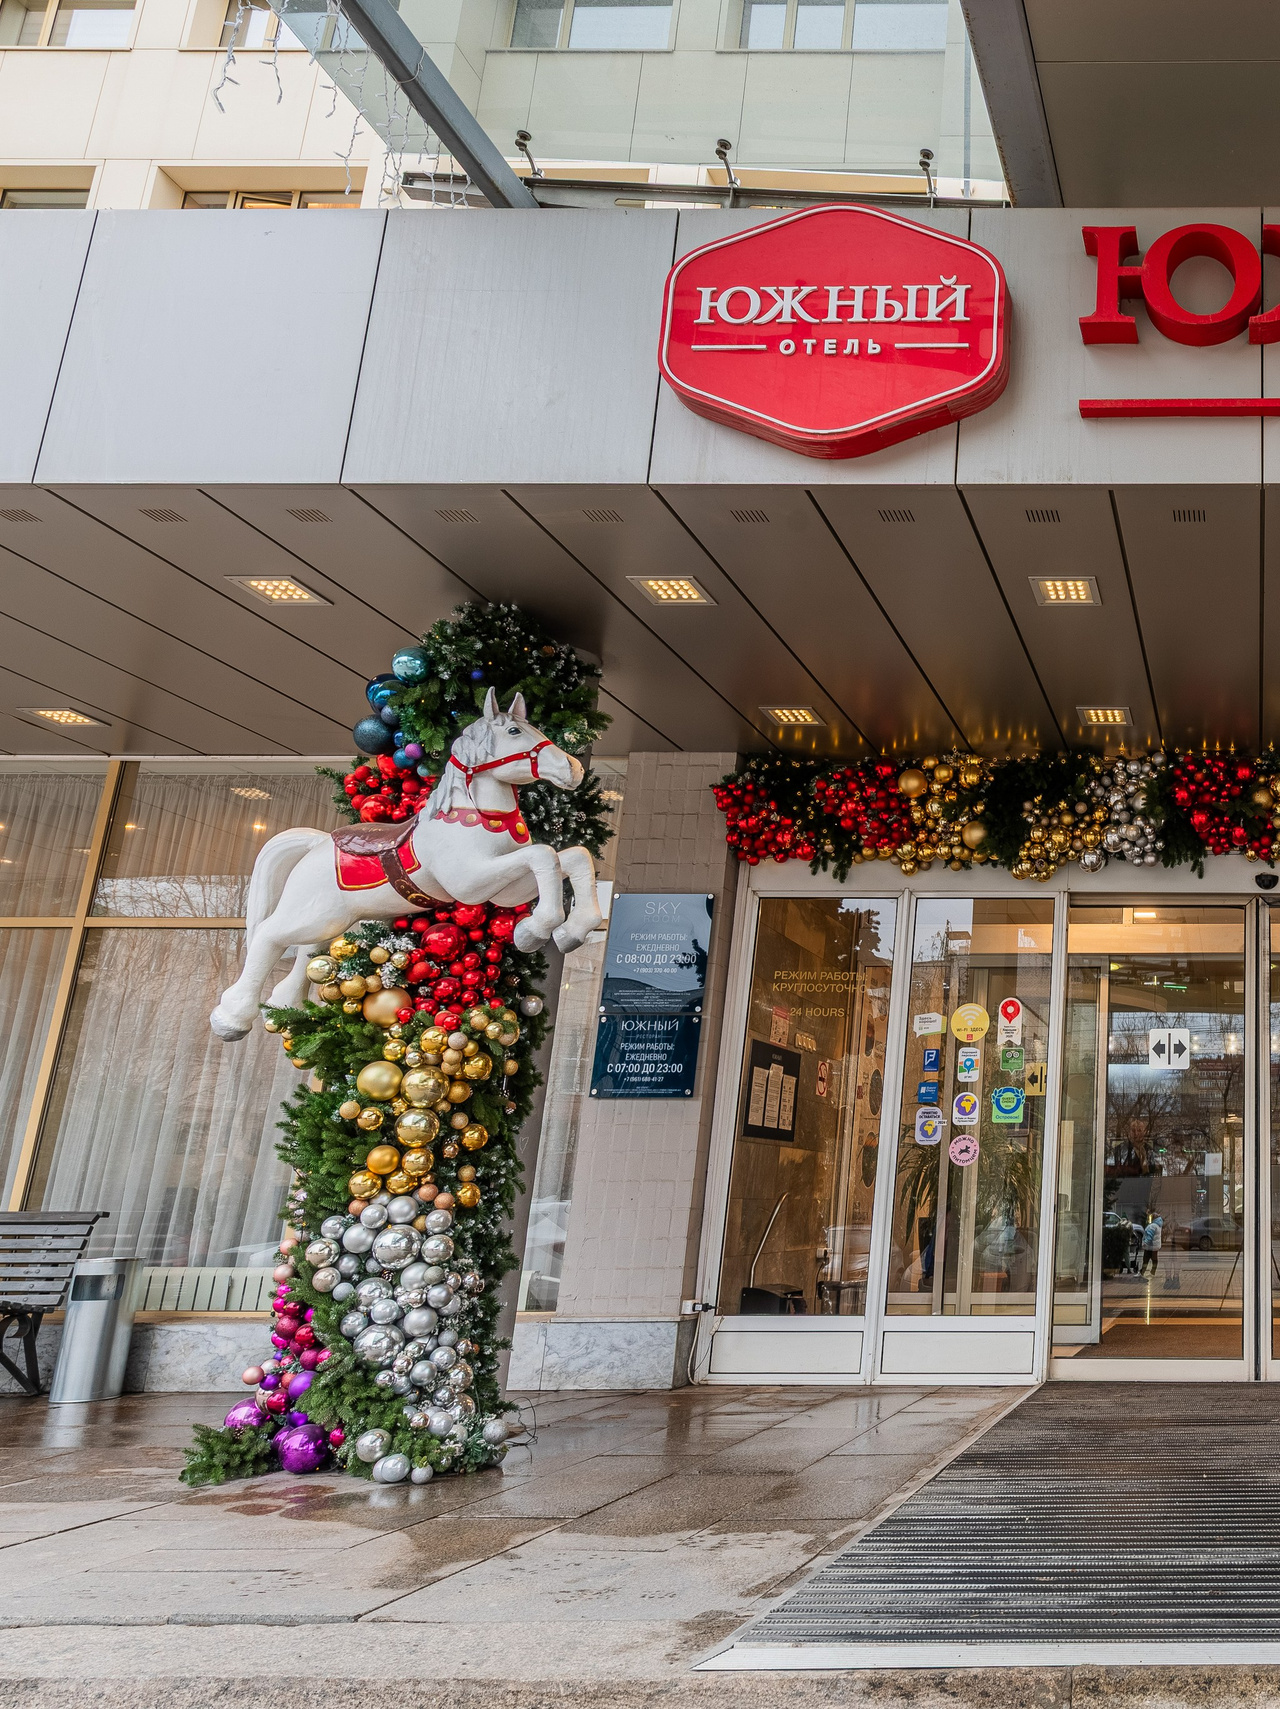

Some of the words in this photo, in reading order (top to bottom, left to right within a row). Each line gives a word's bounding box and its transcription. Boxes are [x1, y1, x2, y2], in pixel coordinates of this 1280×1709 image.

[693, 274, 972, 325] ЮЖНЫЙ
[779, 338, 882, 356] ОТЕЛЬ
[644, 901, 682, 915] SKY
[630, 933, 657, 941] РЕЖИМ
[657, 933, 689, 941] РАБОТЫ:
[635, 943, 681, 953] ЕЖЕДНЕВНО
[624, 953, 653, 964] 08:00
[653, 953, 668, 966] ДО
[669, 953, 697, 964] 23:00
[774, 970, 817, 980] РЕЖИМ
[772, 982, 868, 994] КРУГЛОСУТОЧНО
[790, 1006, 803, 1016] 24
[805, 1007, 845, 1017] HOURS
[621, 1018, 680, 1031] ЮЖНЫЙ
[620, 1042, 646, 1051] РЕЖИМ
[645, 1042, 676, 1051] РАБОТЫ:
[625, 1052, 668, 1062] ЕЖЕДНЕВНО
[615, 1063, 641, 1073] 07:00
[641, 1063, 656, 1075] ДО
[656, 1063, 683, 1073] 23:00
[953, 1136, 975, 1145] МОЖНО
